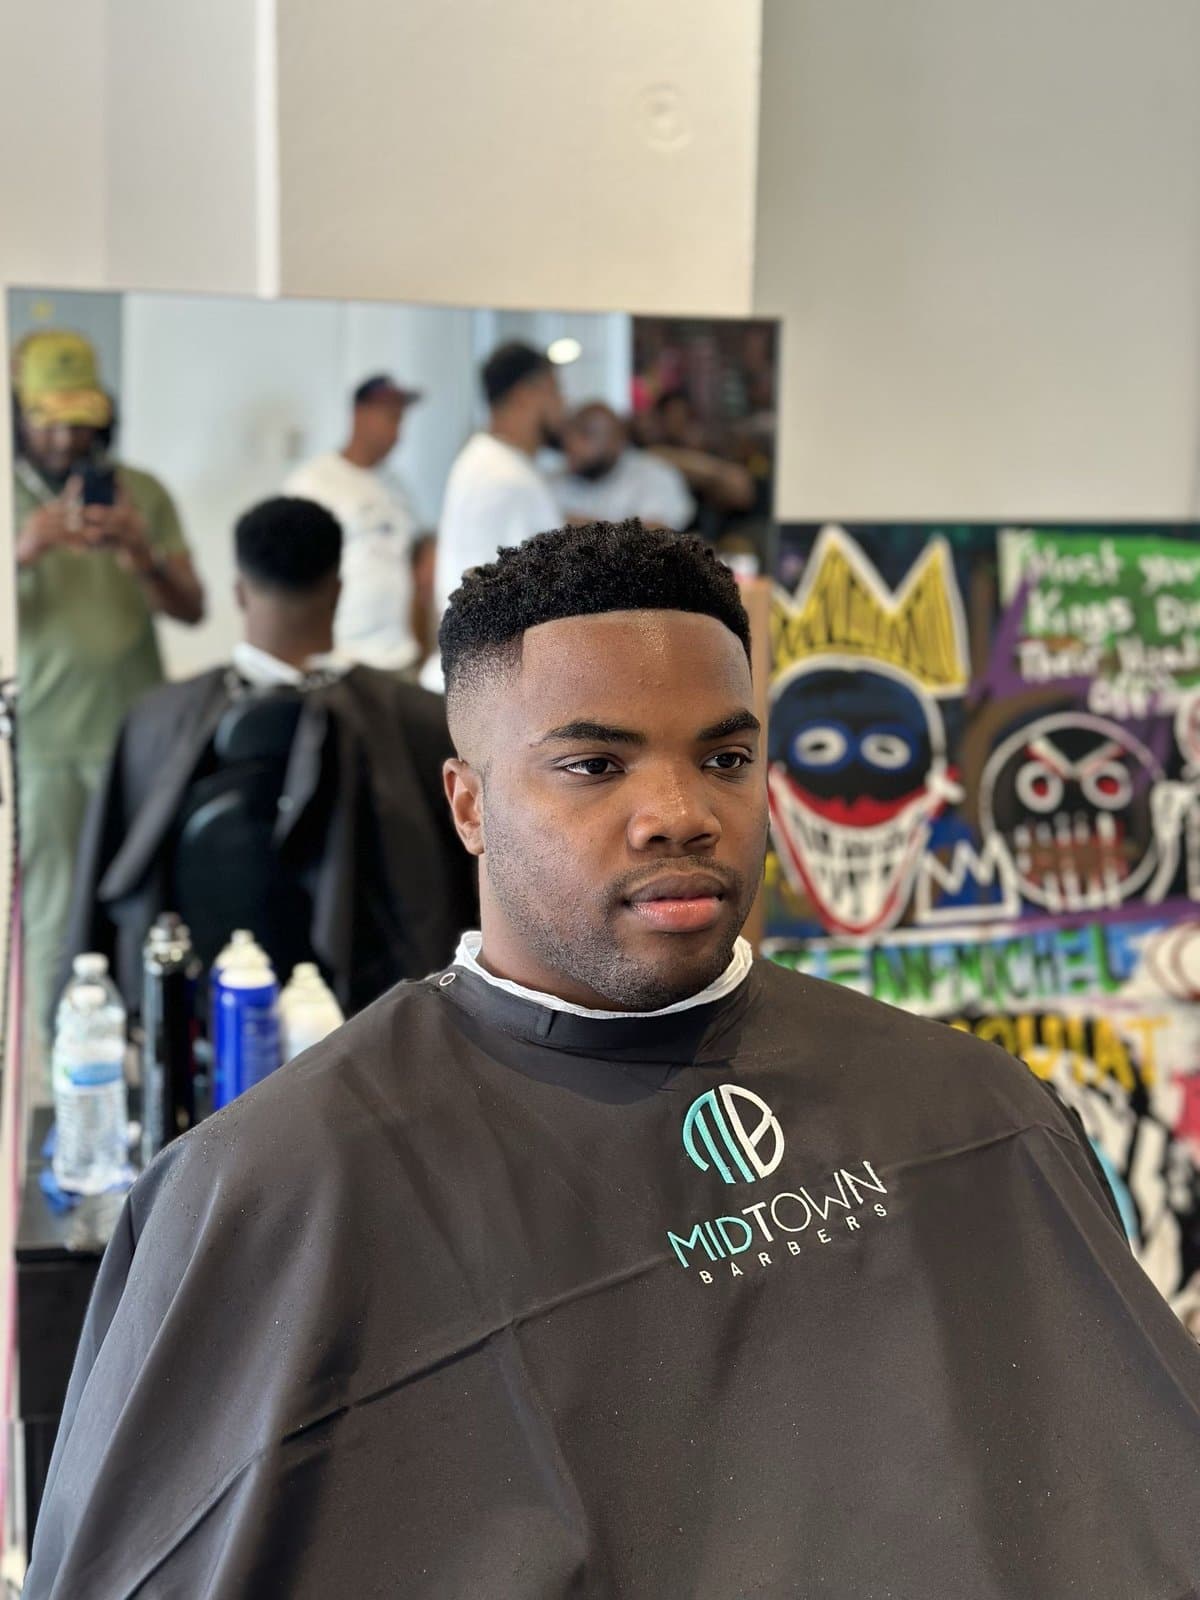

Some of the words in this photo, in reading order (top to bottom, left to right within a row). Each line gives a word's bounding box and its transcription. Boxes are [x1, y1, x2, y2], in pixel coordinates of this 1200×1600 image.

[1028, 587, 1134, 643] Kings
[667, 1160, 888, 1268] MIDTOWN
[699, 1203, 888, 1284] BARBERS
